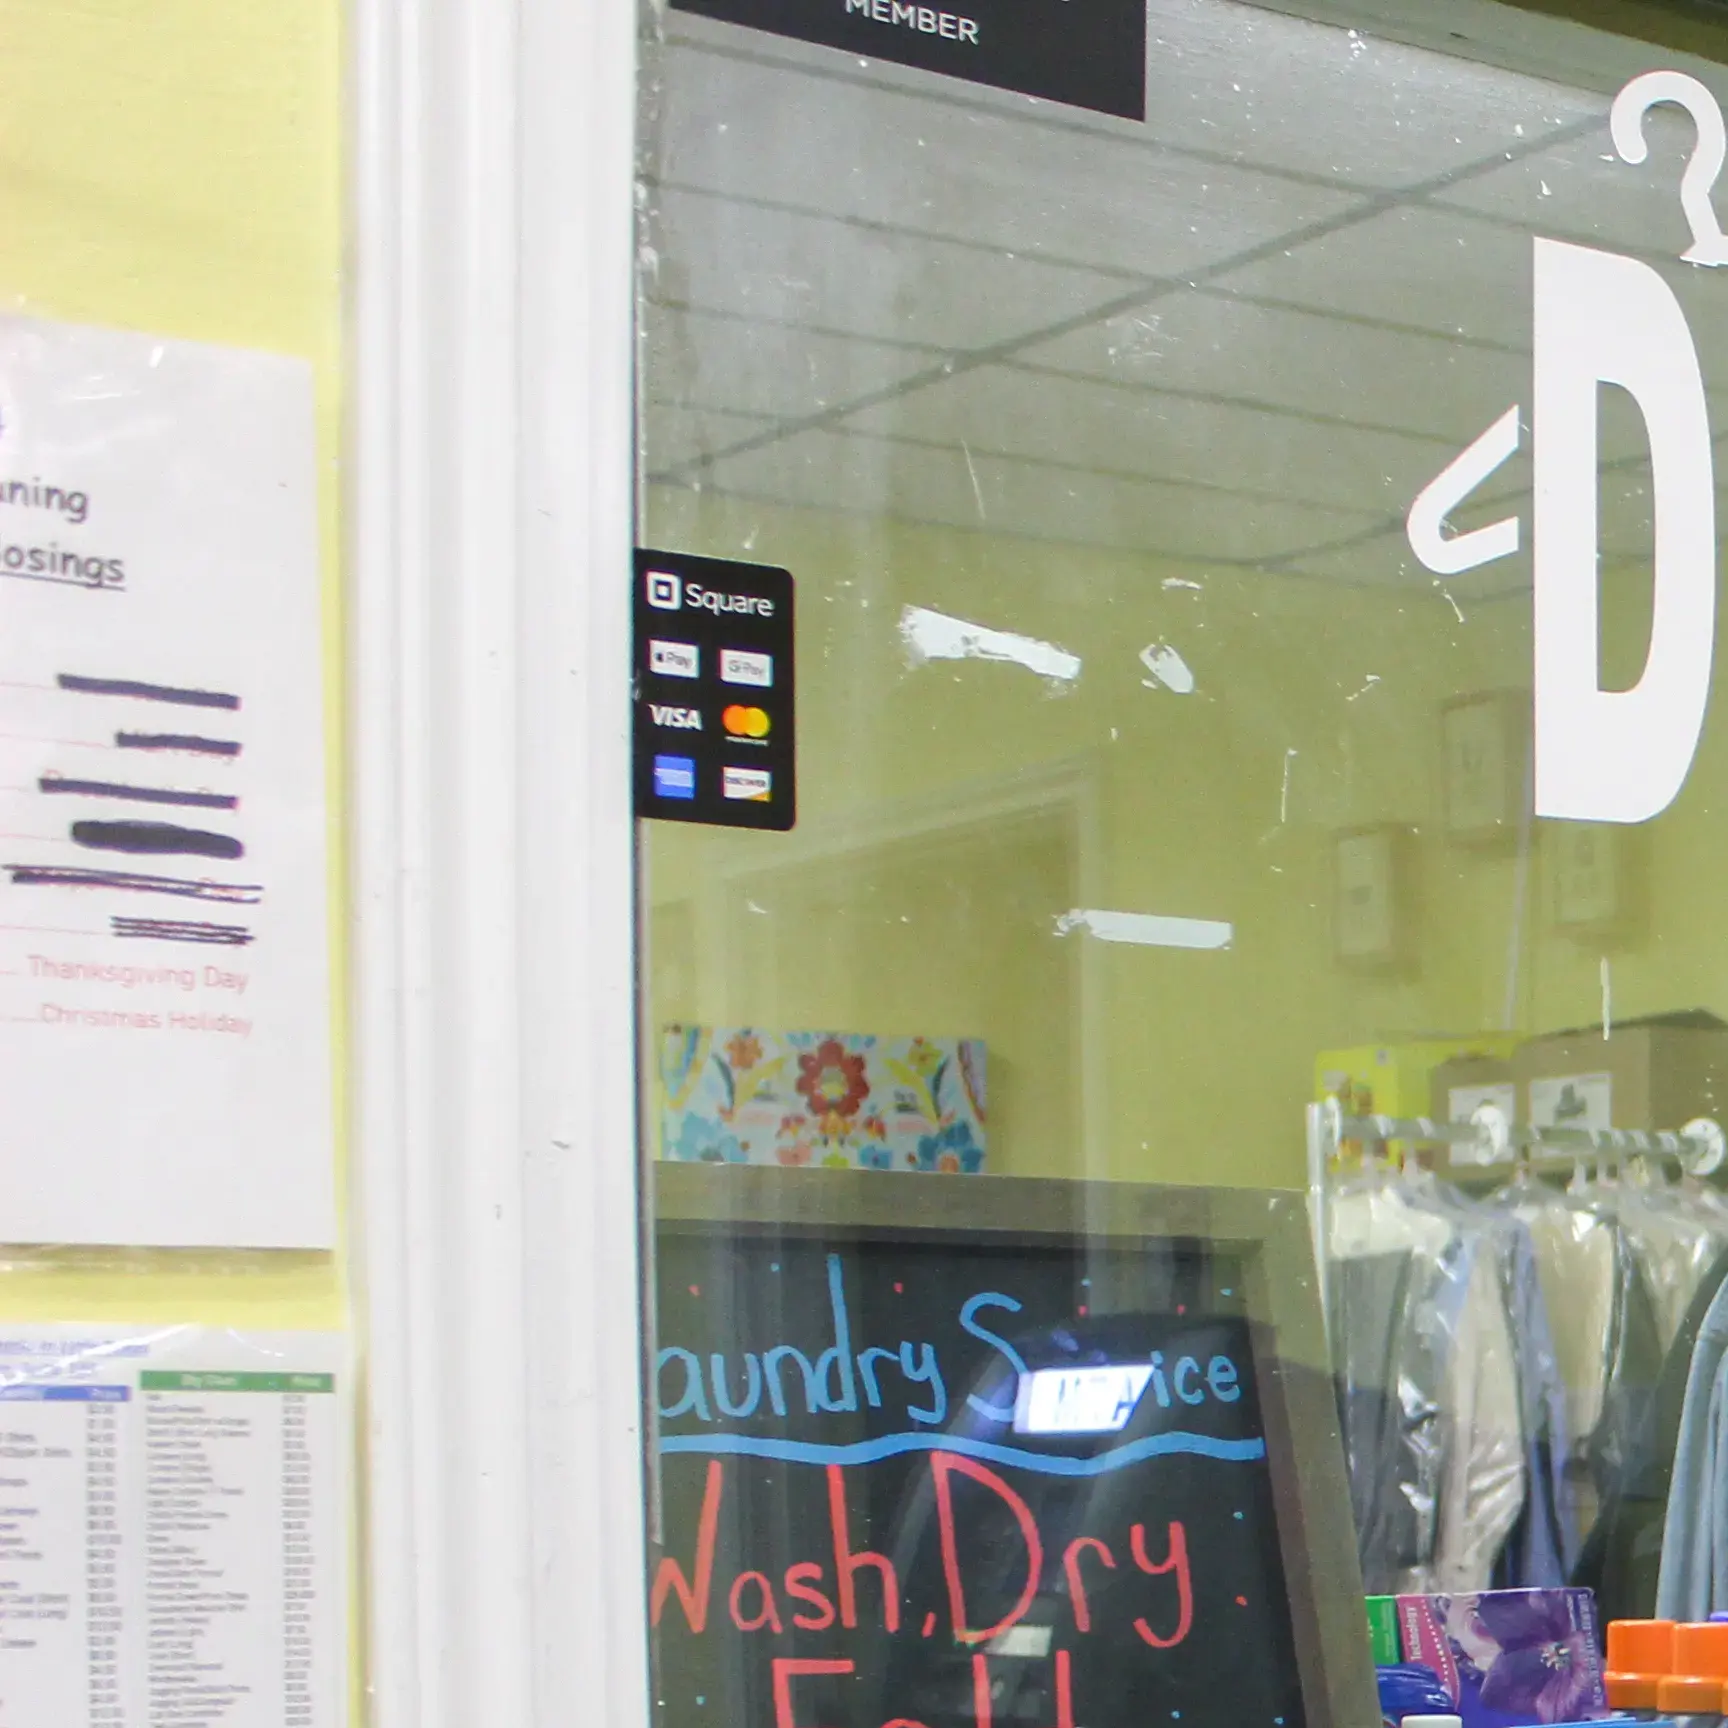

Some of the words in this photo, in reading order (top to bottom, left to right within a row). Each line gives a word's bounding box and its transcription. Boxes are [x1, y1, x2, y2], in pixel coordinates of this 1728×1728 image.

[845, 0, 980, 45] MEMBER
[0, 477, 89, 524] ning
[686, 583, 775, 617] Square
[648, 704, 703, 730] VISA
[655, 1256, 947, 1424] aundry
